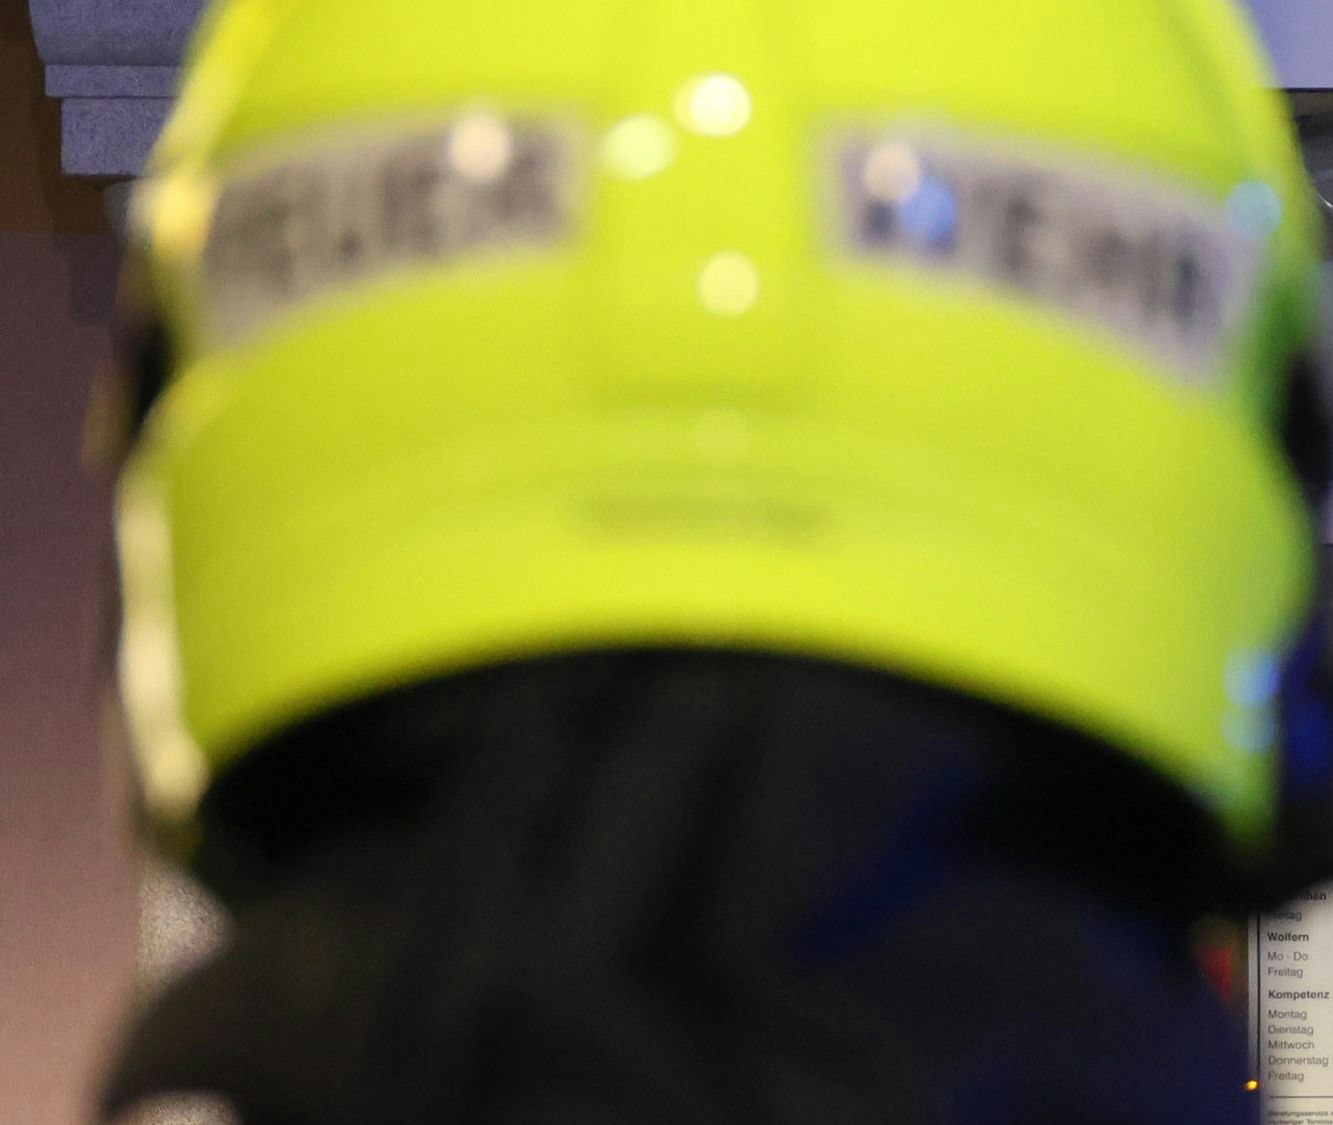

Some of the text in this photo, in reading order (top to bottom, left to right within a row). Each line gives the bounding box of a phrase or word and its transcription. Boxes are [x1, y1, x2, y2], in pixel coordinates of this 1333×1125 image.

[1267, 932, 1309, 942] Wolfern
[1267, 951, 1284, 961] Mo
[1293, 951, 1308, 961] Do
[1268, 967, 1303, 978] Freitag
[1268, 990, 1329, 1001] Kompetenz
[1268, 1010, 1307, 1021] Montag
[1268, 1025, 1314, 1036] Dienstag
[1268, 1040, 1315, 1050] Mittwoch
[1268, 1056, 1328, 1067] Donnerstag
[1268, 1071, 1304, 1082] Freitag
